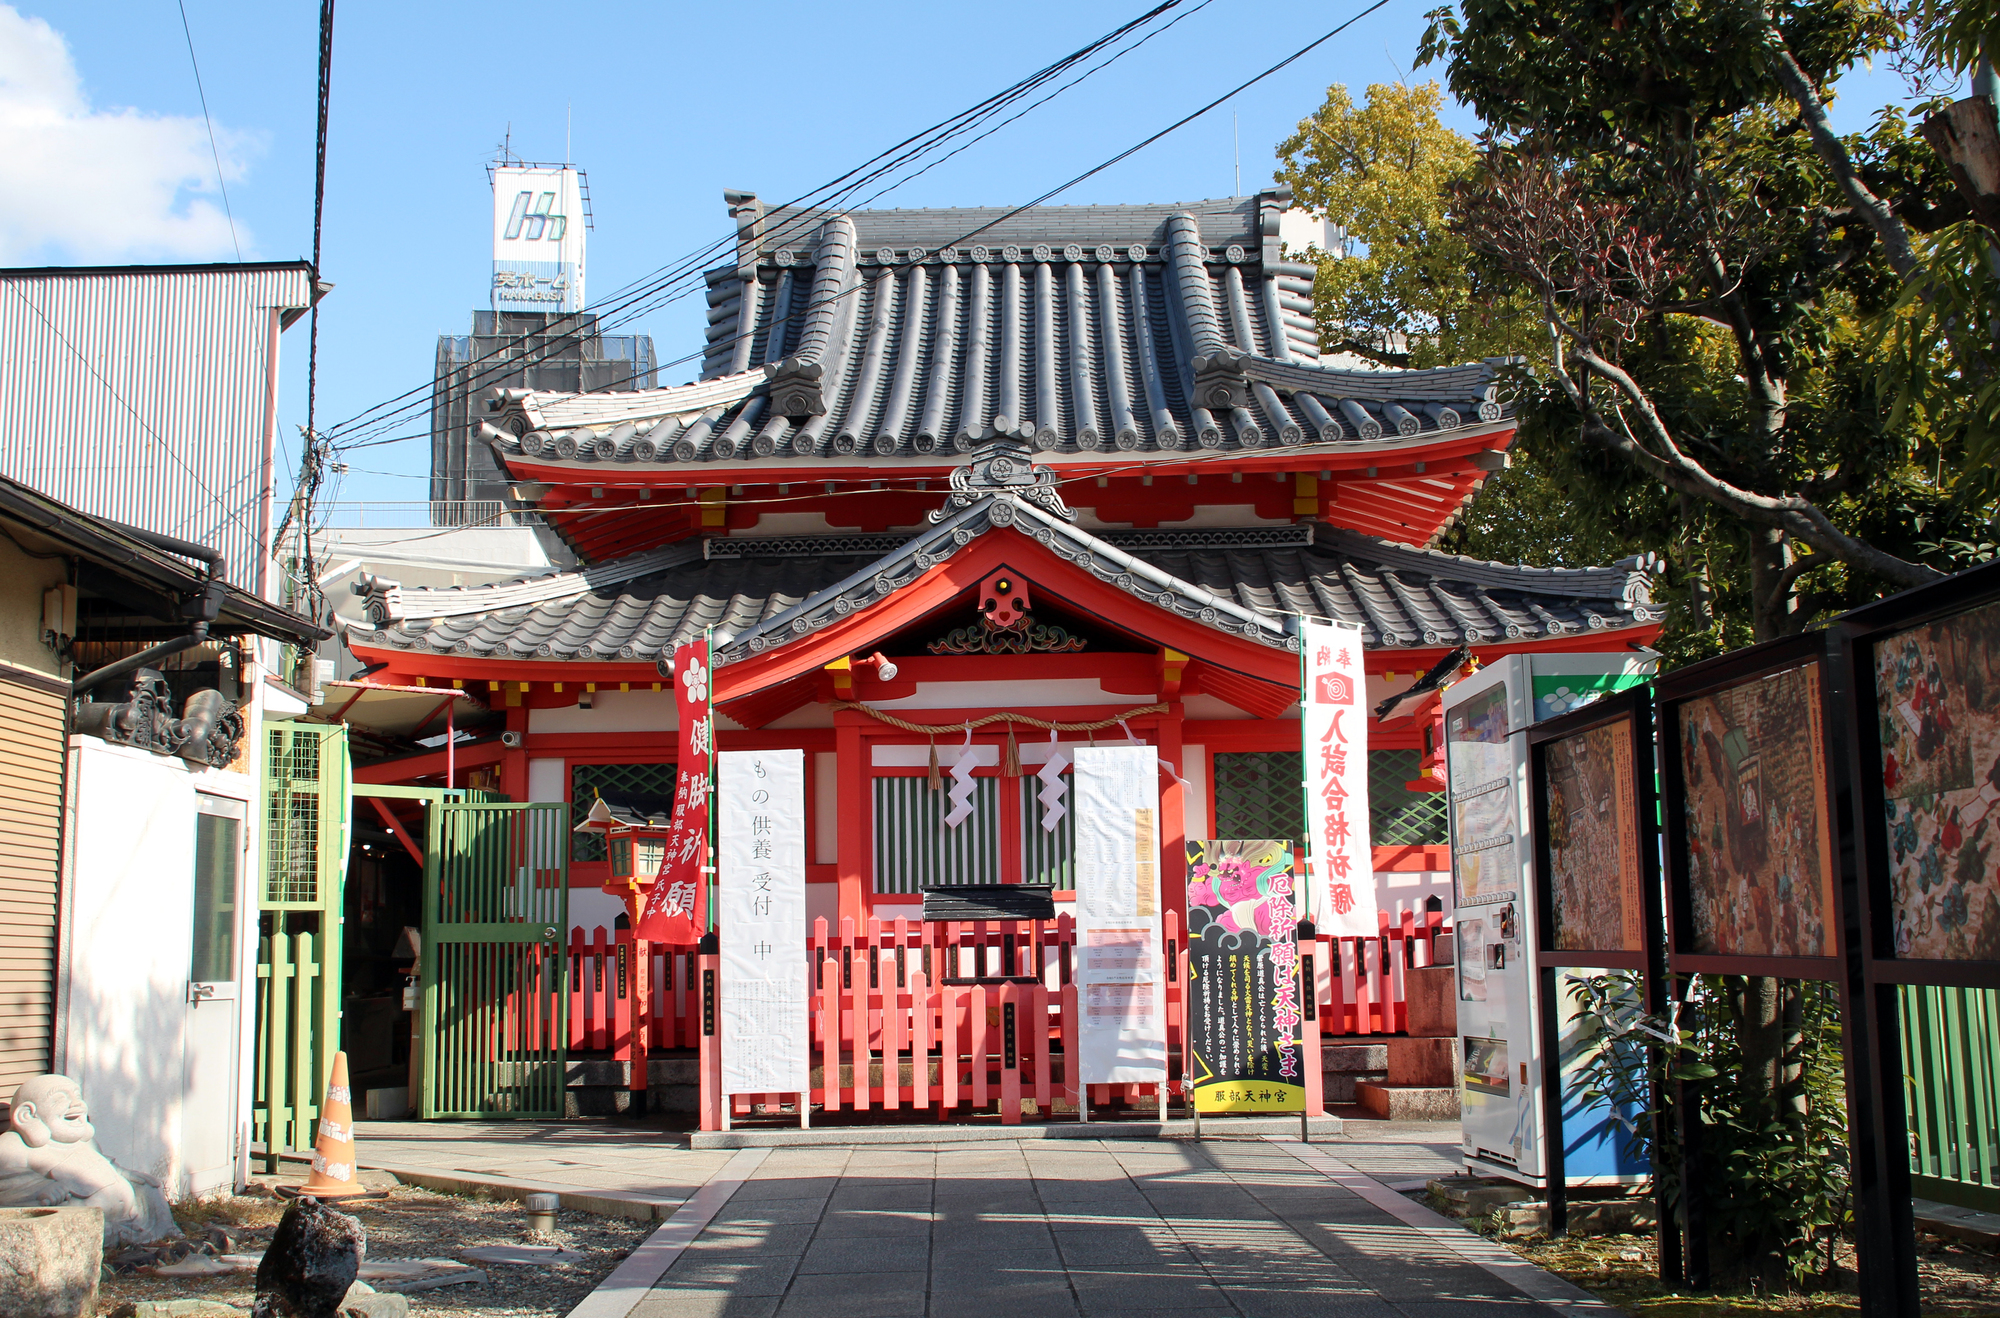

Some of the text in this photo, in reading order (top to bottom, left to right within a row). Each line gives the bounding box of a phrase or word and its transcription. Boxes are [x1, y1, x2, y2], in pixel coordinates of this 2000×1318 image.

[495, 271, 571, 290] 英ホーム
[500, 290, 566, 302] HANABUSA
[660, 715, 714, 921] 健脚祈願
[1266, 873, 1300, 1078] 厄除祈願は天神さま
[1214, 1089, 1288, 1103] 服部天神宮
